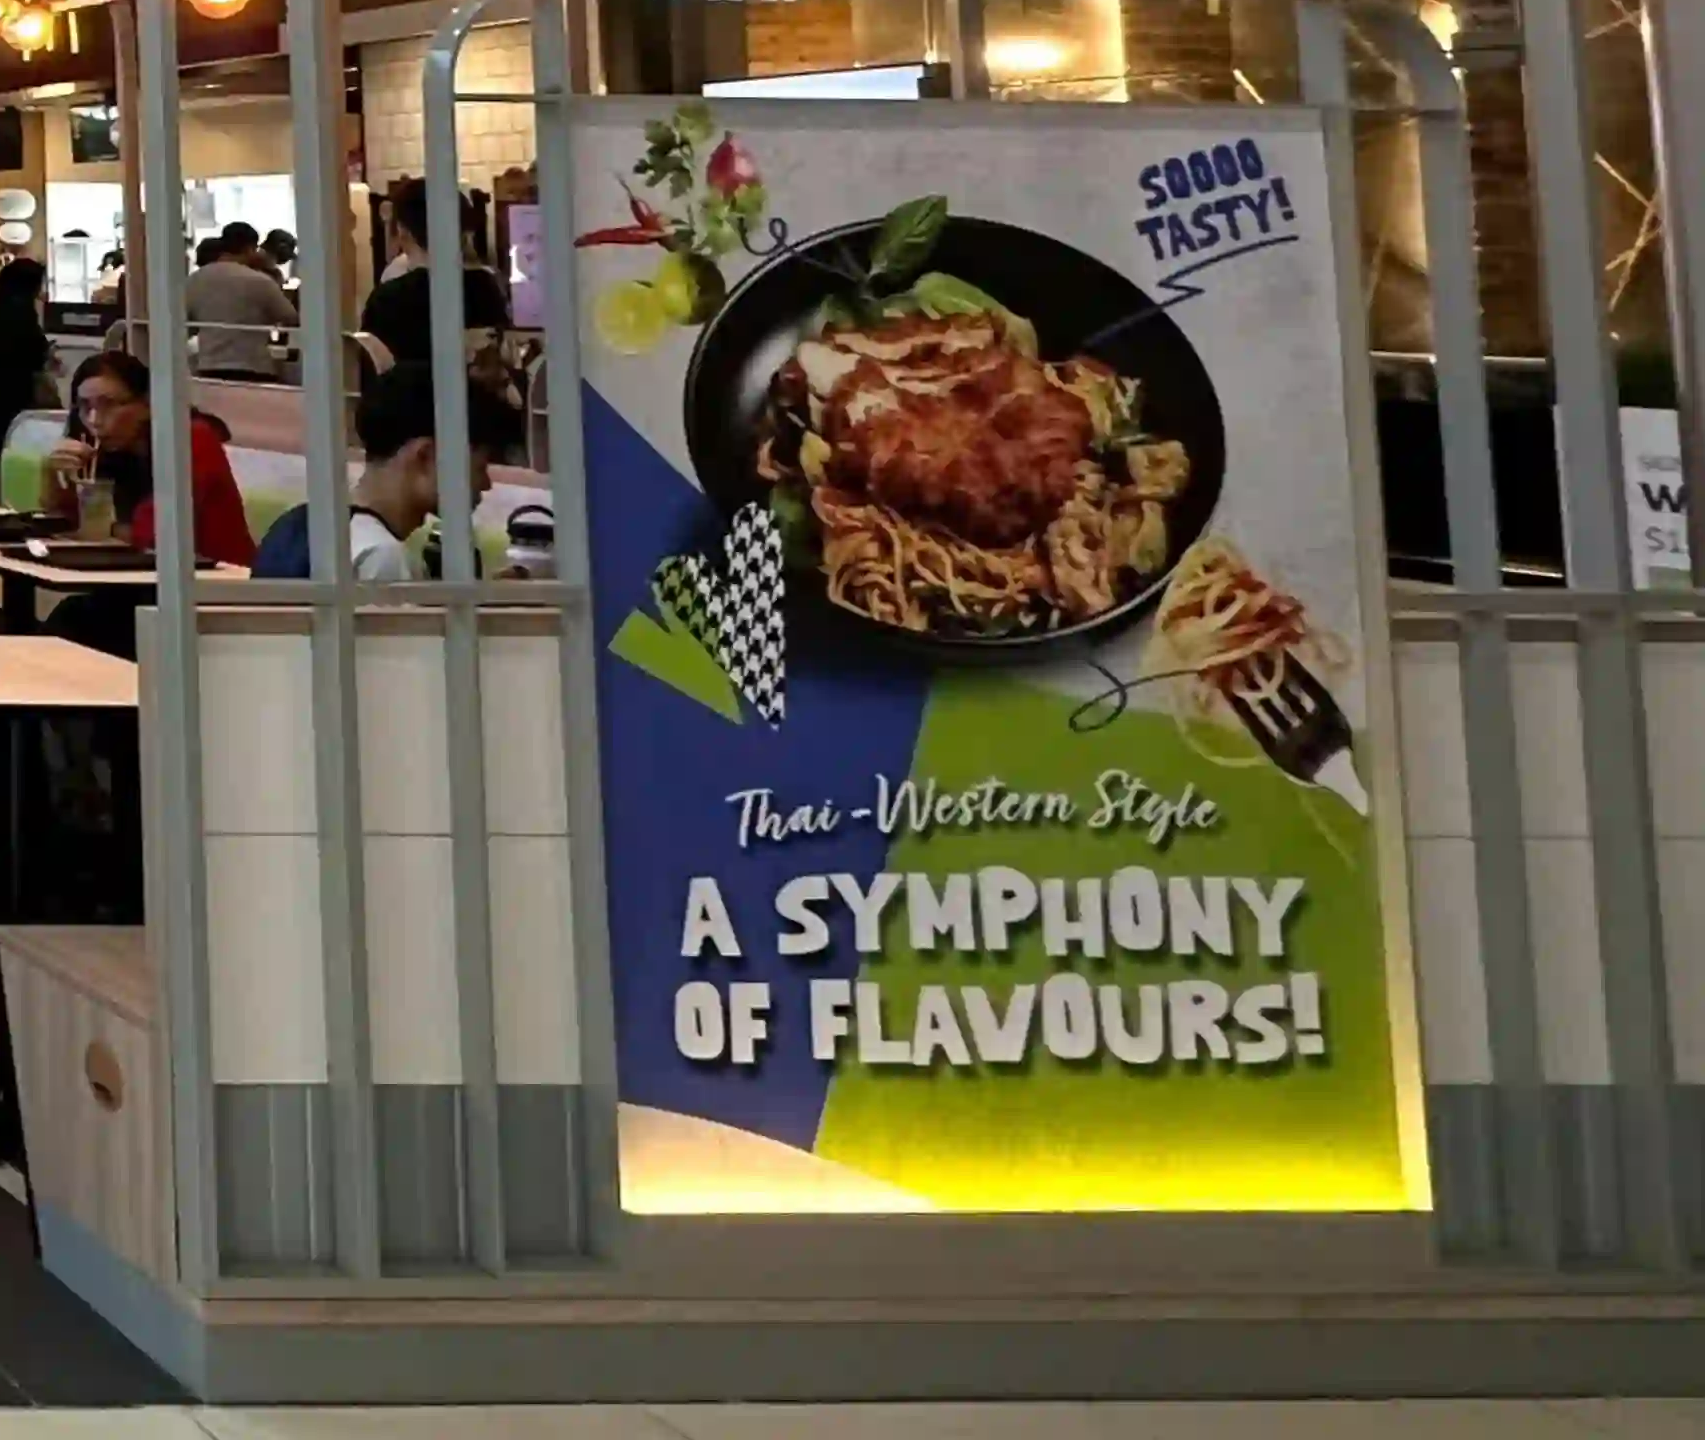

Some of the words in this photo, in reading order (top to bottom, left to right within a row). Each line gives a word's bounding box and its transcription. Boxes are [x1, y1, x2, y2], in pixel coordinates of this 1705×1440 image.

[1138, 137, 1264, 210] SOOOO
[1135, 176, 1296, 260] TASTY!
[1088, 768, 1221, 846] Style
[681, 877, 742, 958] A
[774, 865, 1306, 959] SYMPHONY
[675, 980, 772, 1064] OF
[809, 972, 1326, 1067] FLAVOURS!
